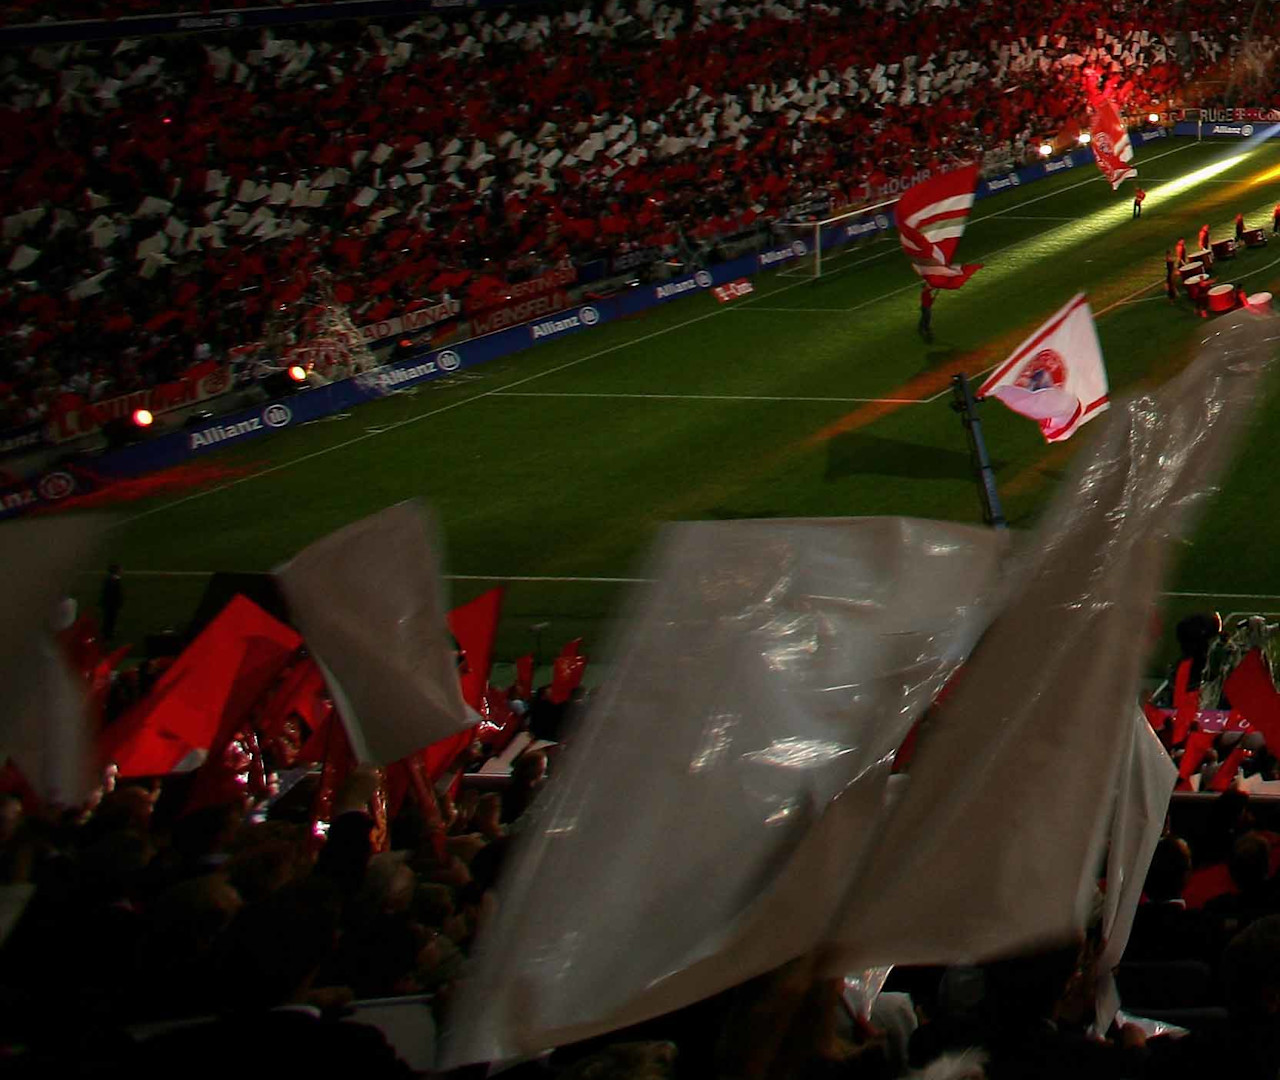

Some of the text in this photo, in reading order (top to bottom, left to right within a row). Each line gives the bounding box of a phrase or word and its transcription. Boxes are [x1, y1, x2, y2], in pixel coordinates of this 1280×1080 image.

[1212, 125, 1242, 135] Allianz
[655, 277, 697, 300] Allianz
[531, 316, 581, 340] Allianz
[188, 415, 264, 451] Allianz
